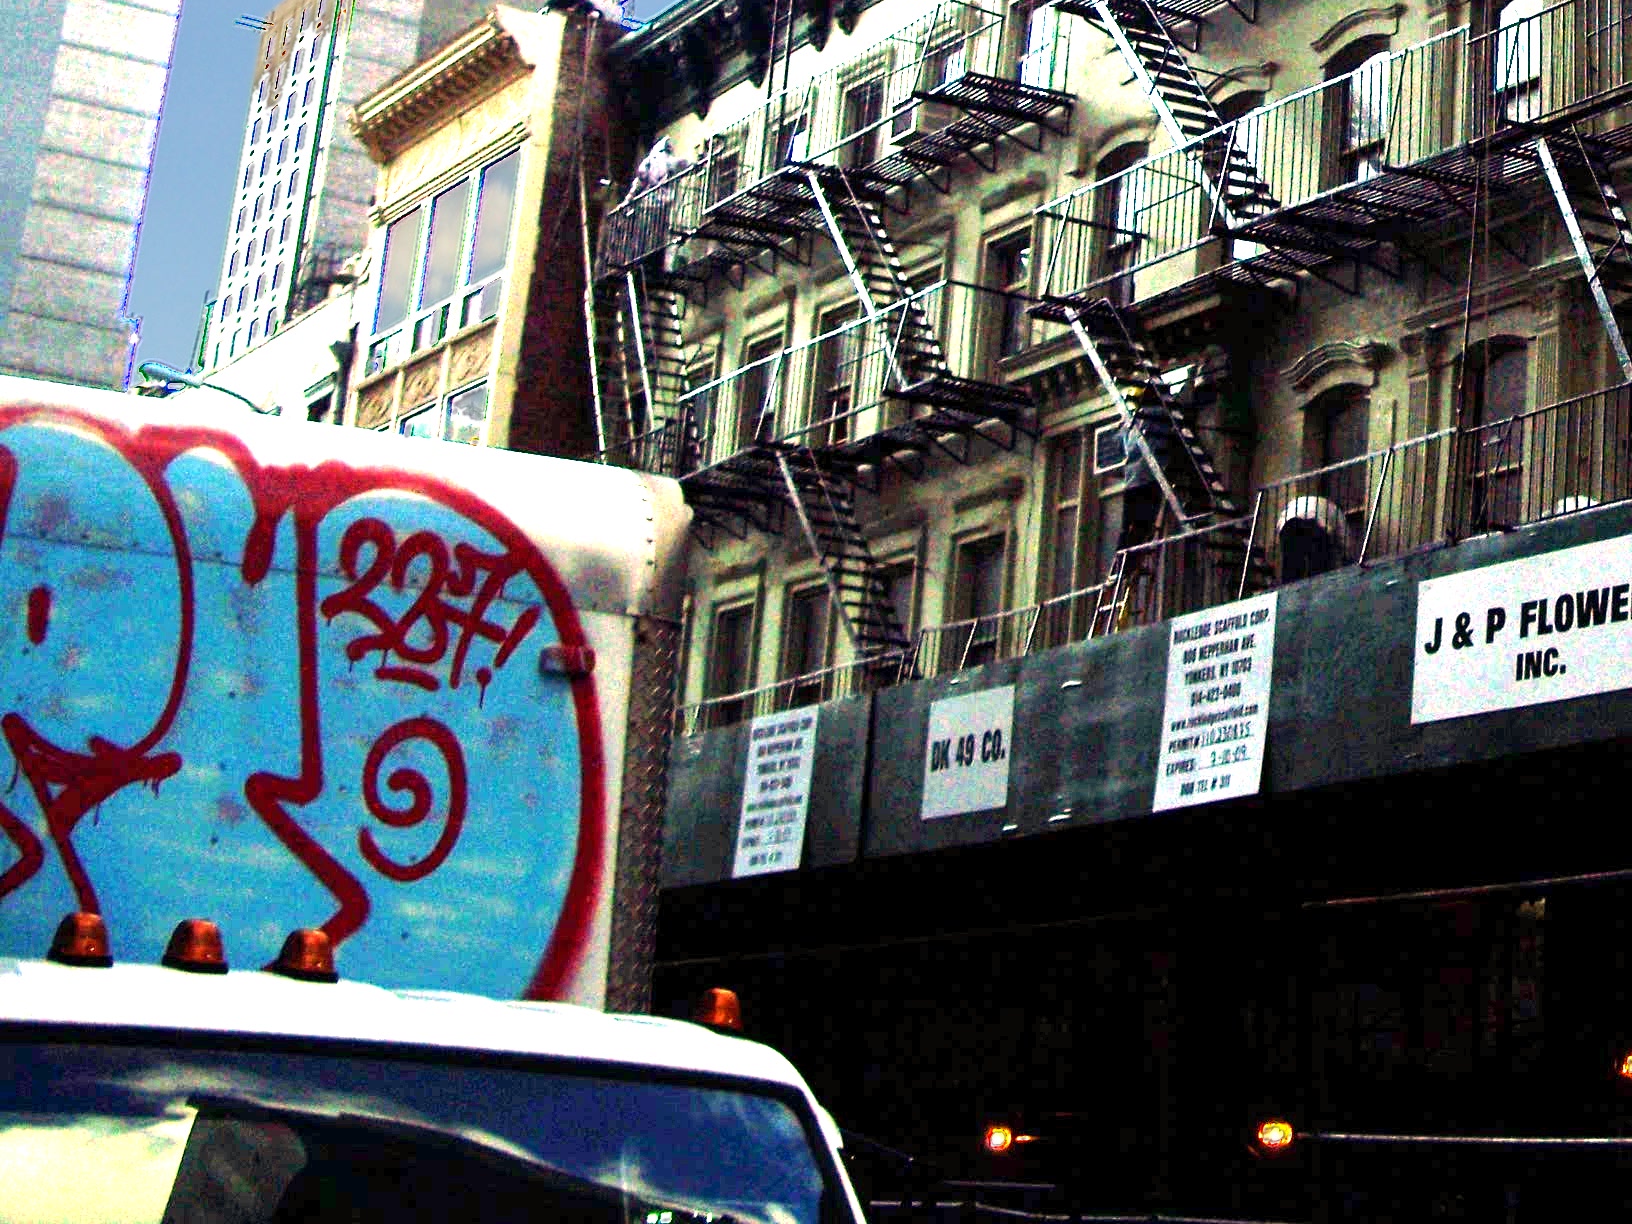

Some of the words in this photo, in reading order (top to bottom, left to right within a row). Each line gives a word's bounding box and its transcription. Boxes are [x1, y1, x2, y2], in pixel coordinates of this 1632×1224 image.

[1424, 617, 1443, 655] J
[1451, 611, 1474, 650] &
[1485, 606, 1506, 644] P
[1515, 647, 1567, 682] INC.
[956, 733, 975, 768] 49
[981, 728, 1006, 763] CO.
